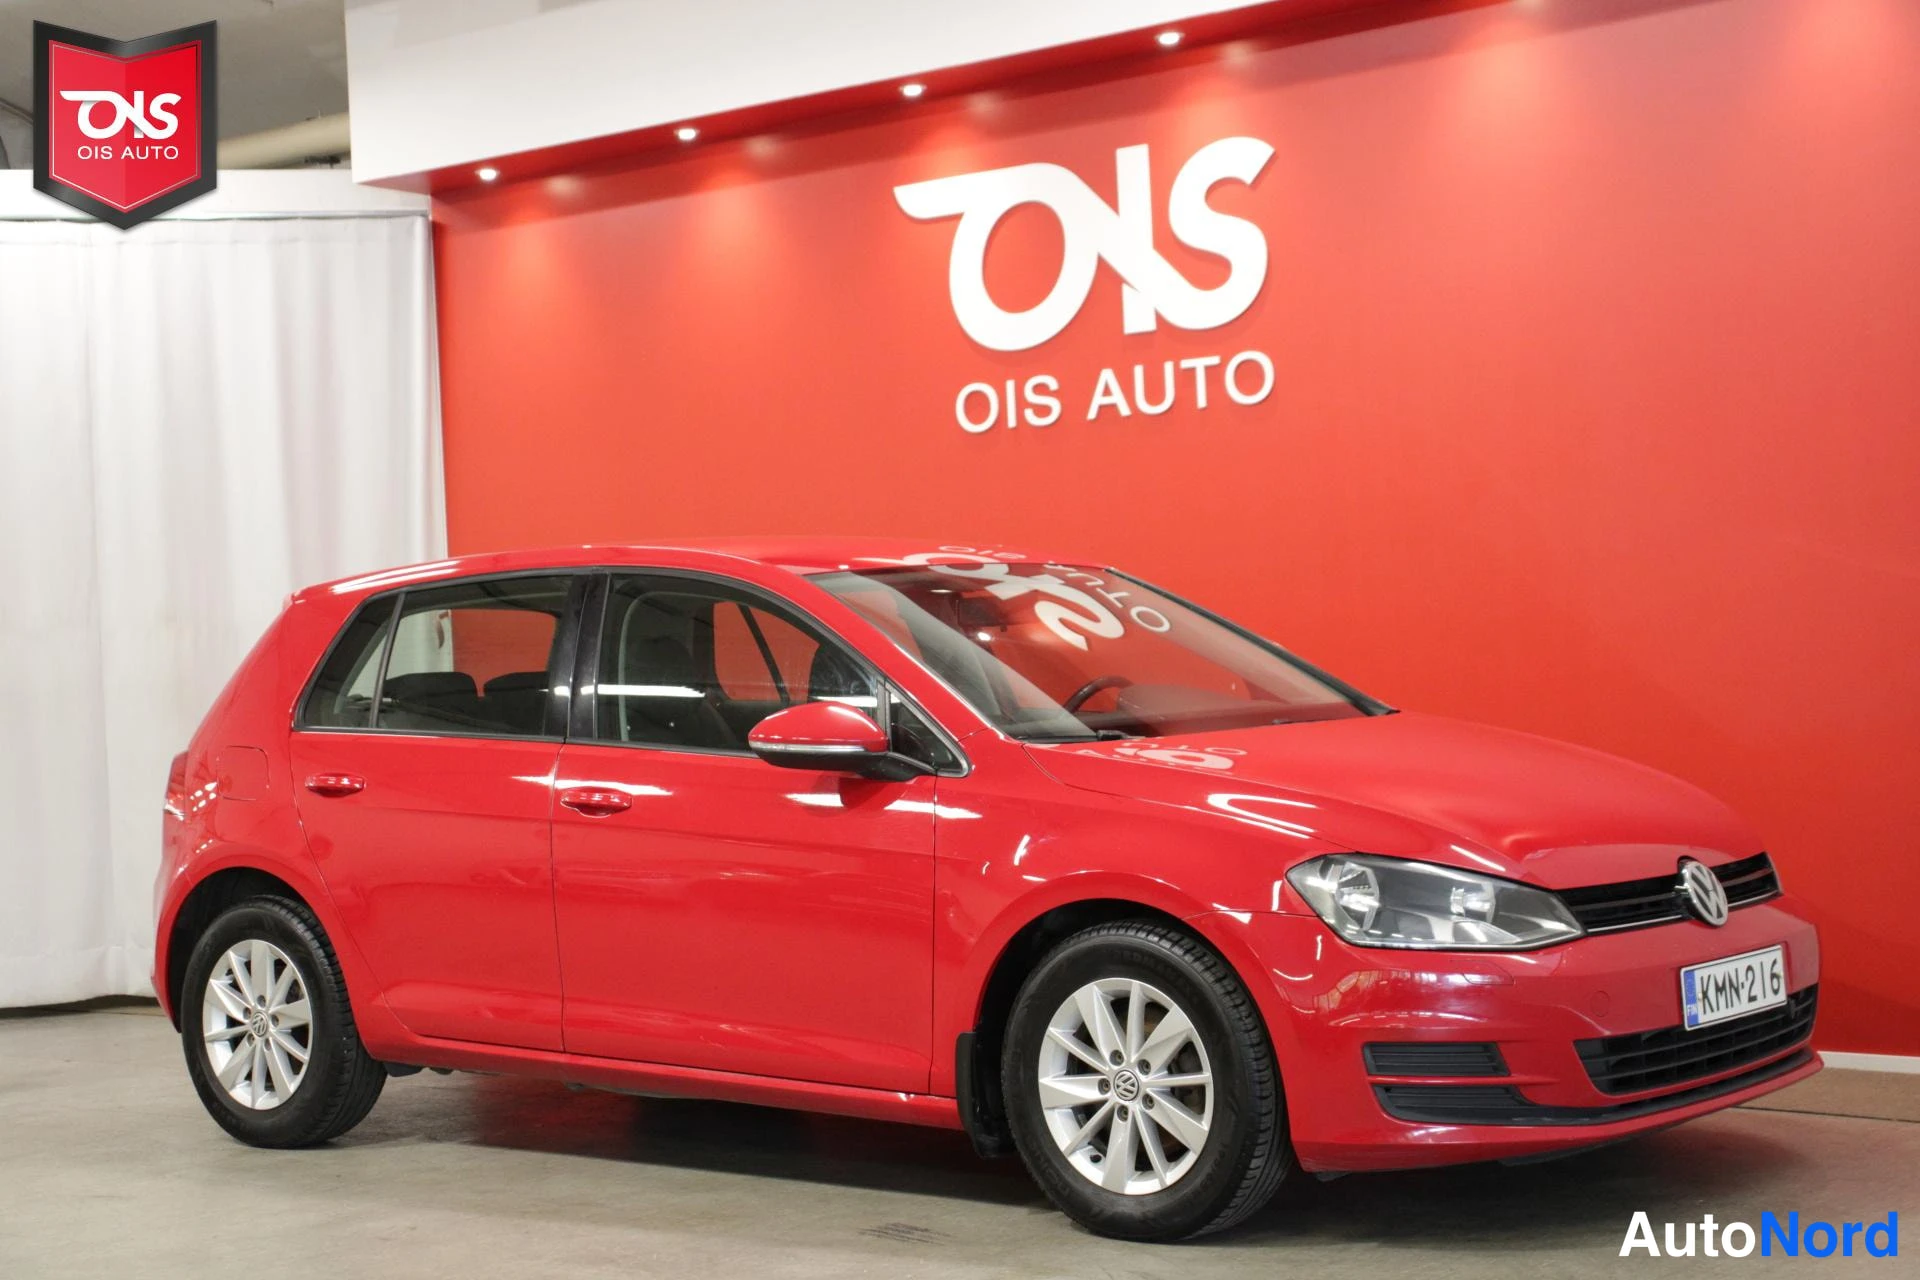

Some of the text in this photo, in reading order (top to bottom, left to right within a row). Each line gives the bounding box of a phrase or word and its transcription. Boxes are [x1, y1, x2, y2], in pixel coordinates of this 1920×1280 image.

[955, 350, 1275, 434] OIS AUTO
[1700, 957, 1783, 1015] KMN-216
